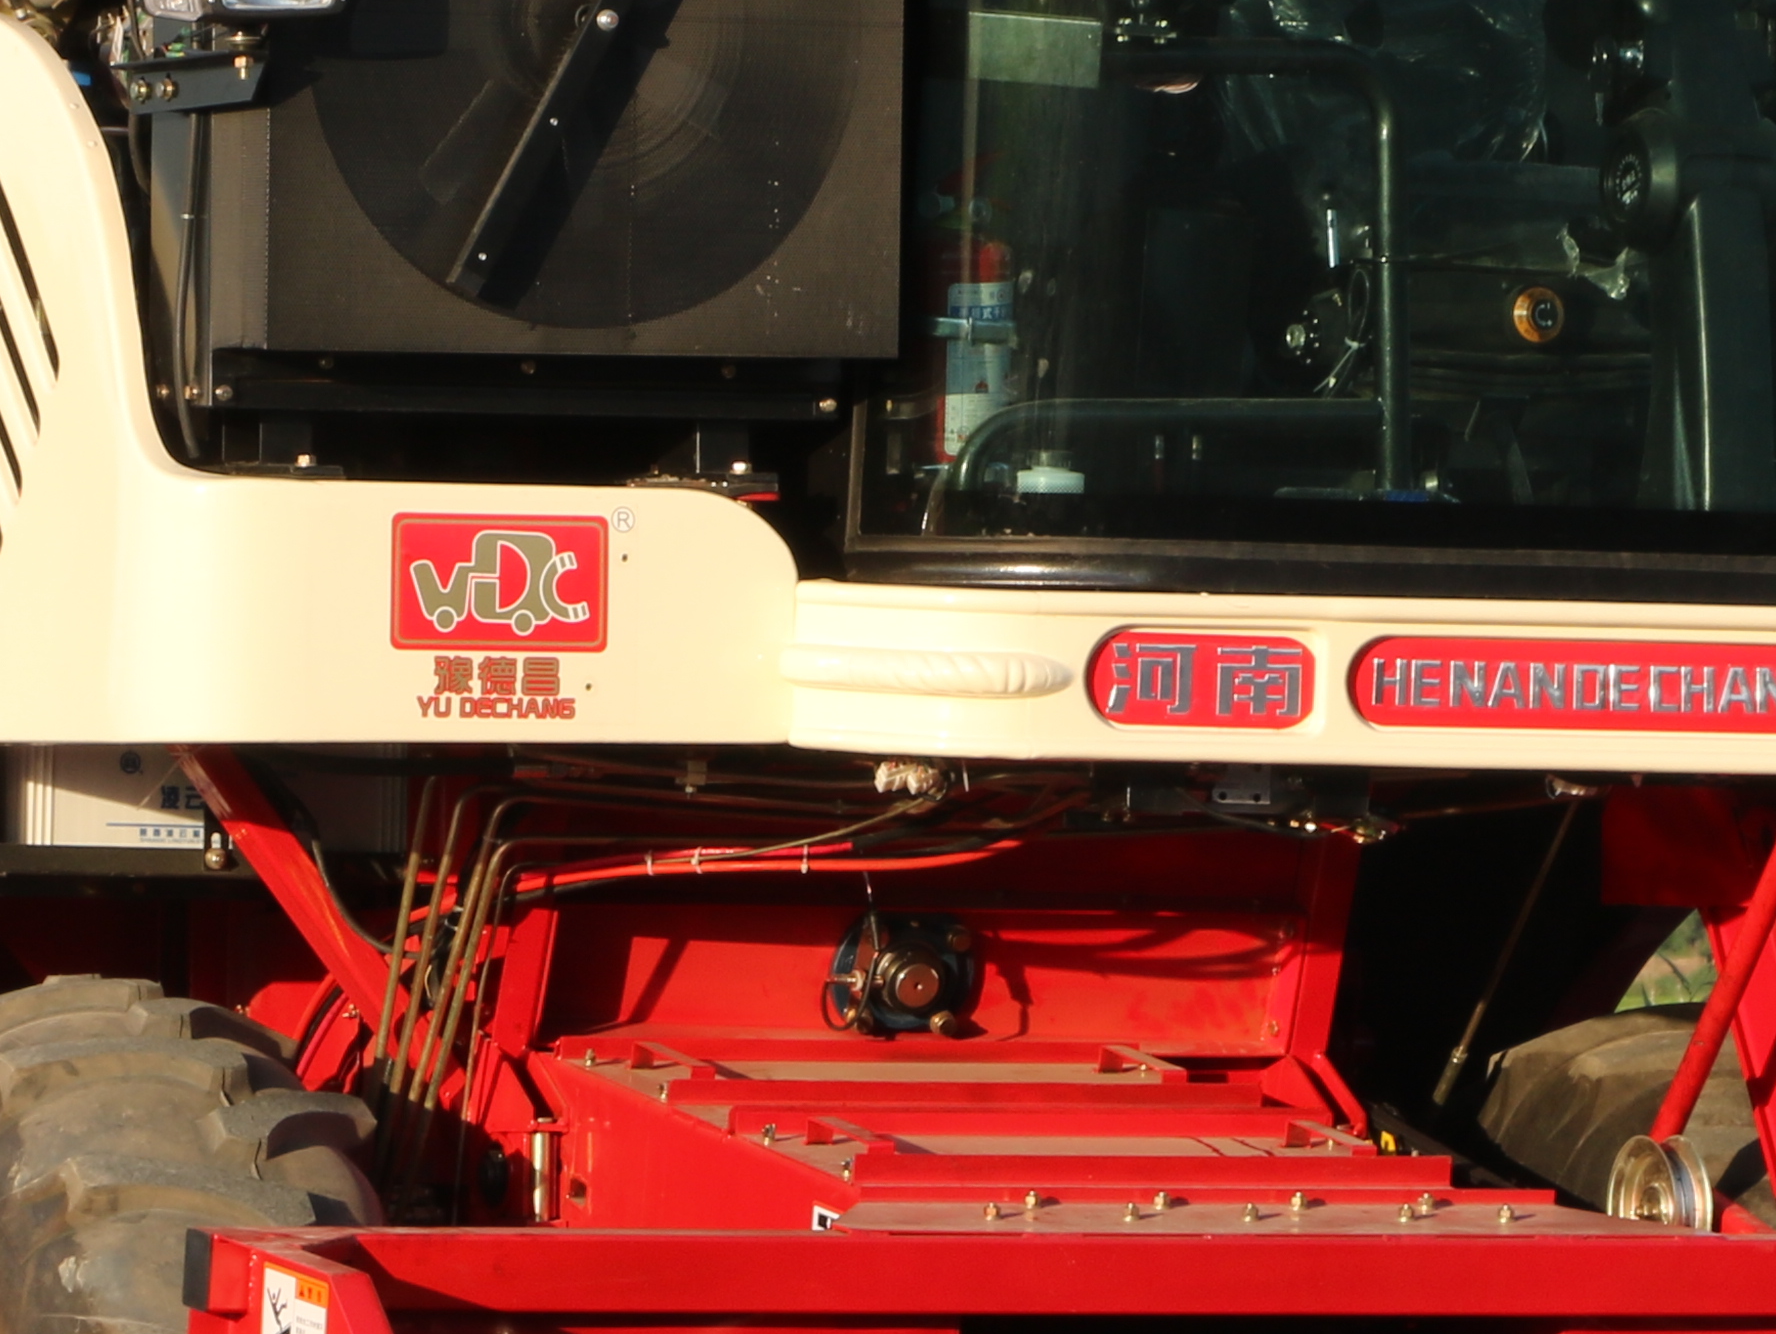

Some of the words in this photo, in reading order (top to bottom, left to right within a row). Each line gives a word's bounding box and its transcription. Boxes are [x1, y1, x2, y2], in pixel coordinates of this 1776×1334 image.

[434, 656, 561, 696] 豫德昌
[1106, 643, 1302, 715] 河南
[417, 696, 452, 718] YU
[459, 697, 576, 719] DECHANG
